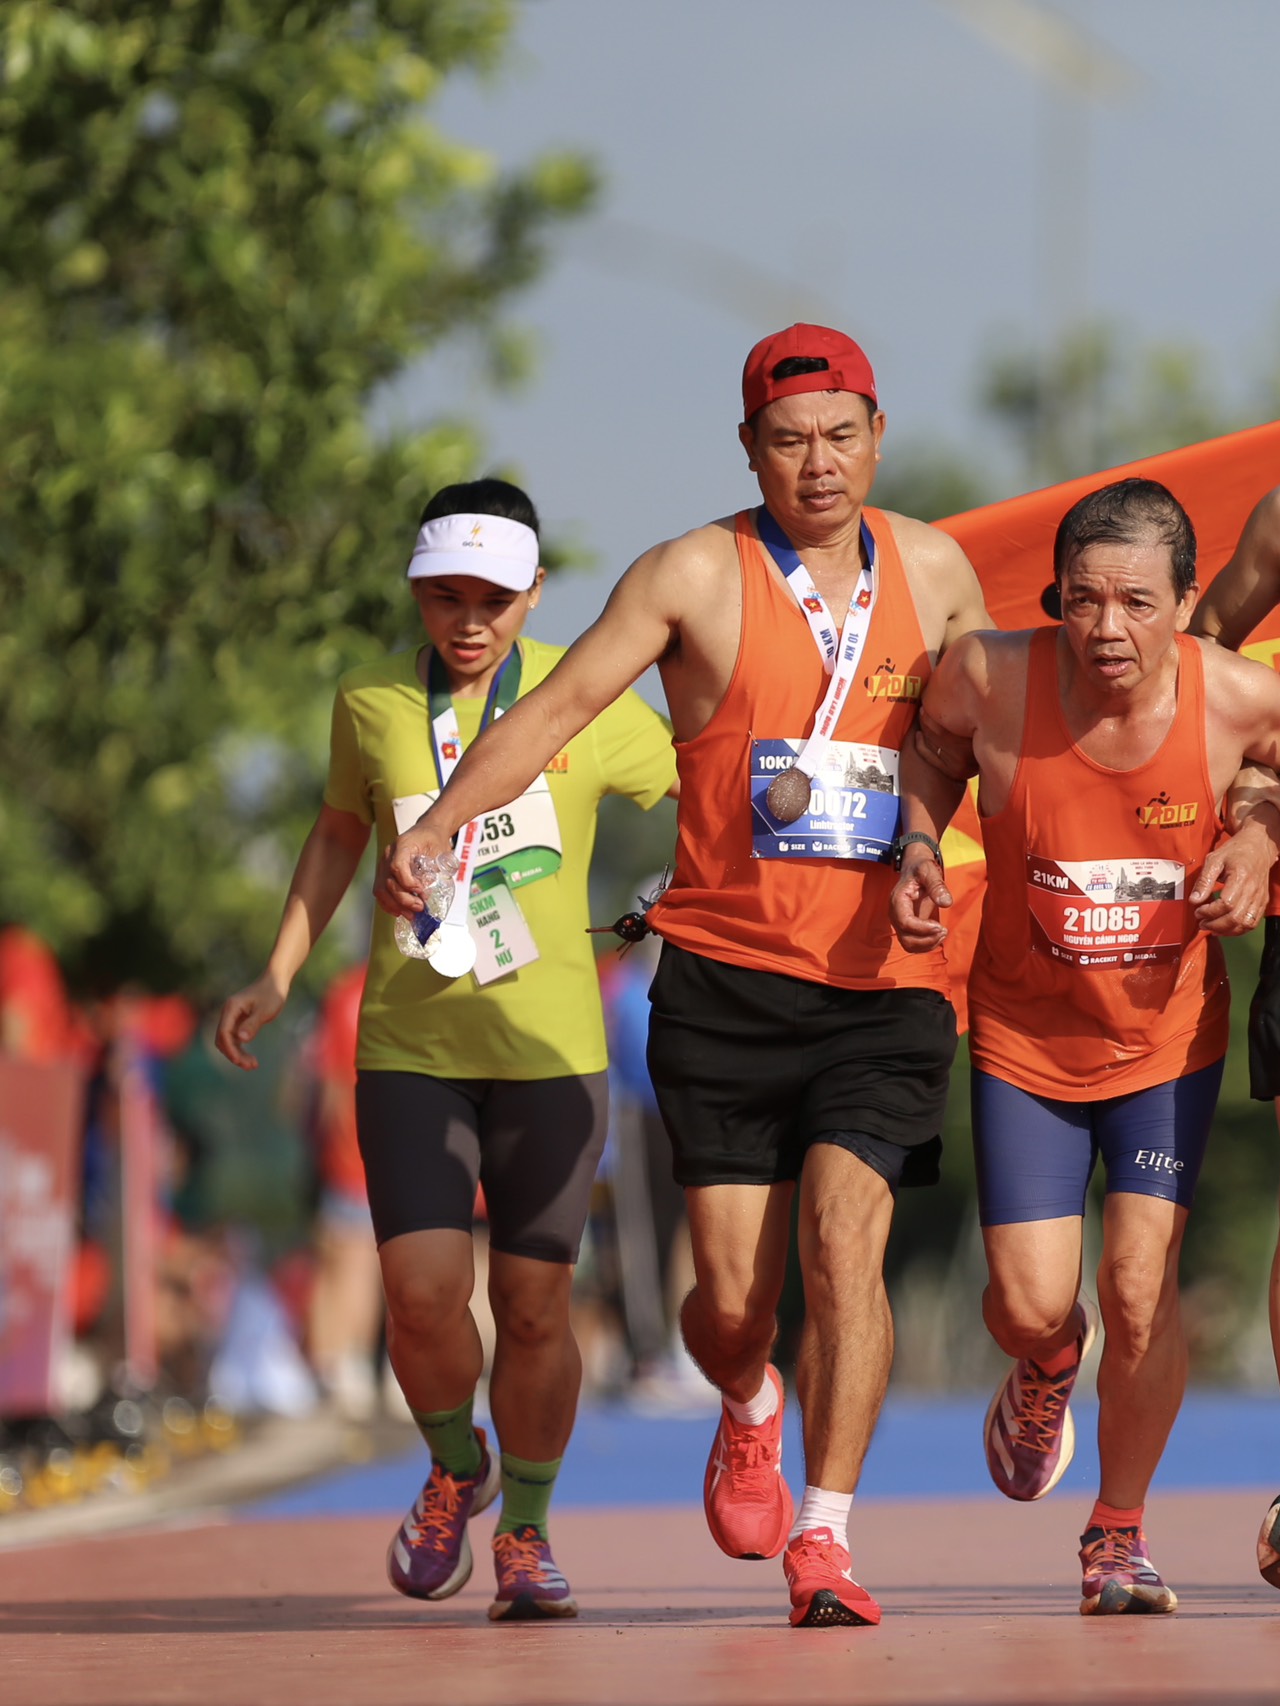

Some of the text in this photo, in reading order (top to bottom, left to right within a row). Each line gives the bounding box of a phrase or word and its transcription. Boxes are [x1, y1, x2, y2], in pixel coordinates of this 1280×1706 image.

[820, 628, 833, 646] KM
[844, 632, 859, 661] 10 KM
[1033, 869, 1069, 890] 21KM
[469, 895, 496, 916] 5KM
[1063, 905, 1140, 932] 21085
[489, 928, 505, 950] 2
[1061, 952, 1073, 961] SIZE
[1090, 955, 1118, 964] RACEKIT
[1134, 1149, 1184, 1174] Elite
